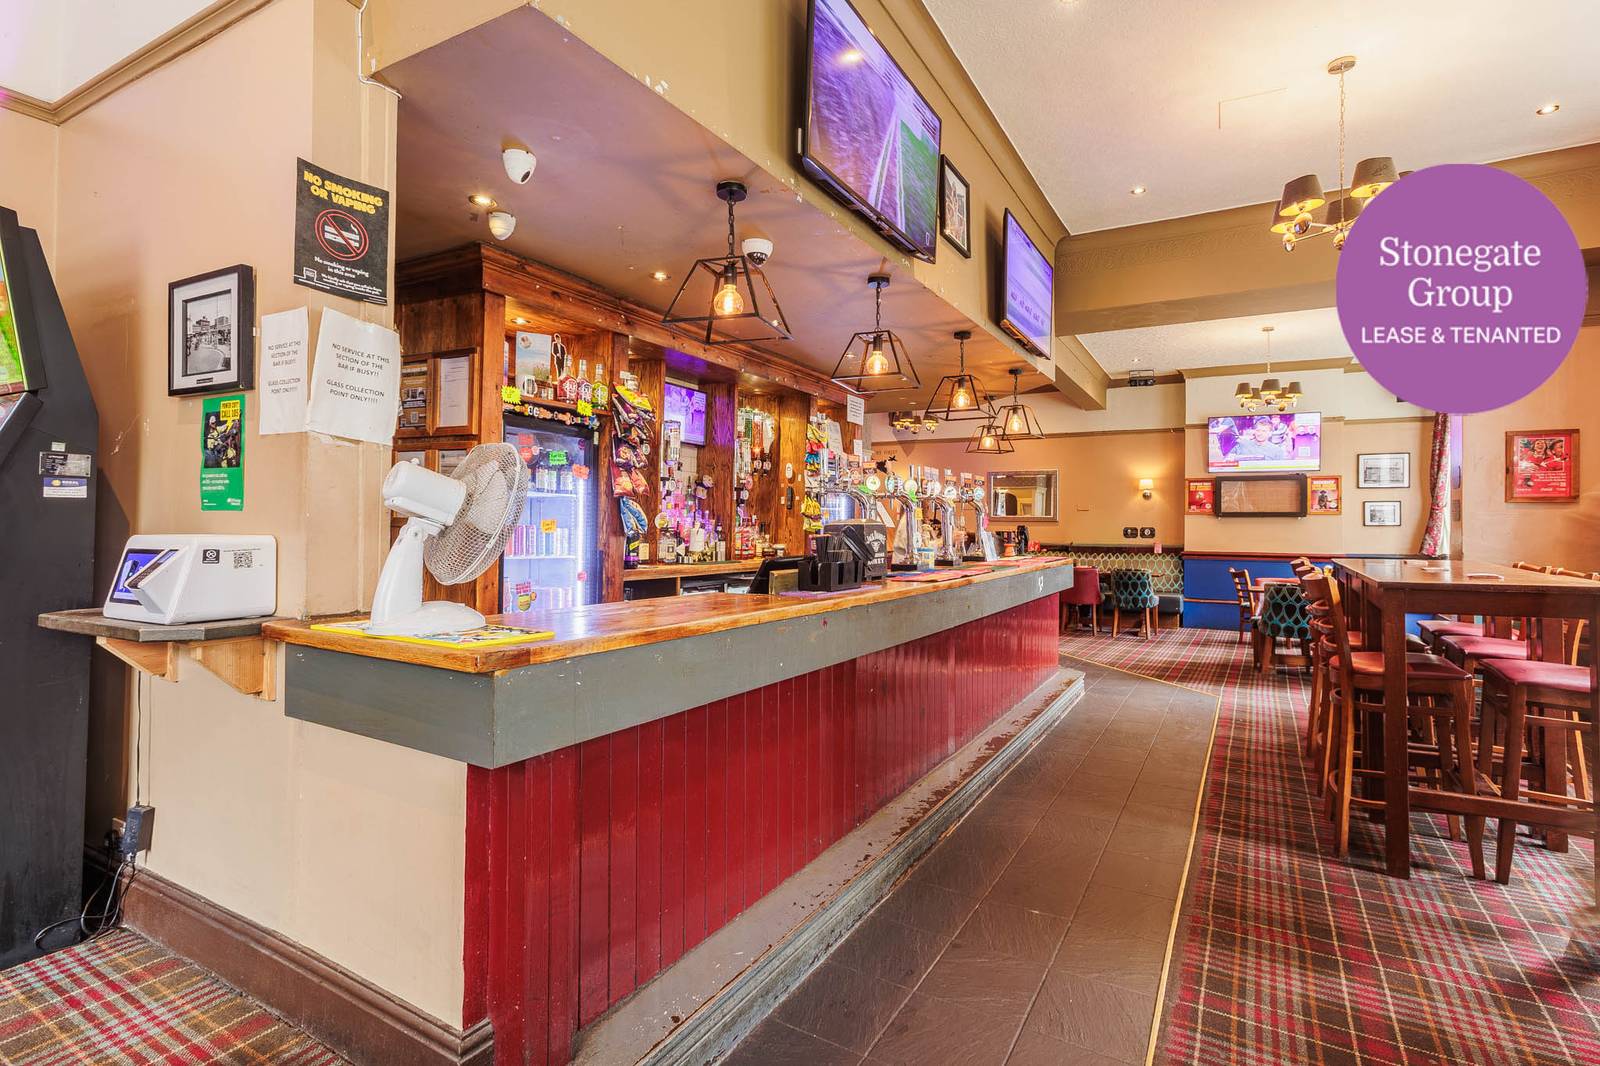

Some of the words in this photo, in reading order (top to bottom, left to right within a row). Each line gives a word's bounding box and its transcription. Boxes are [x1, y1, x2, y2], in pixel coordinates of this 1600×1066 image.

[303, 170, 322, 187] NO
[324, 180, 383, 207] SMOKING
[310, 185, 329, 200] OR
[331, 192, 376, 215] VAPING
[323, 261, 345, 271] smoking
[352, 269, 369, 278] vaping
[336, 352, 359, 364] SECTION
[371, 362, 383, 370] THE
[342, 346, 365, 357] SERVICE
[377, 355, 390, 364] THIS
[337, 362, 349, 370] BAR
[326, 379, 344, 388] GLASS
[345, 384, 385, 397] COLLECTION
[330, 388, 349, 397] POINT
